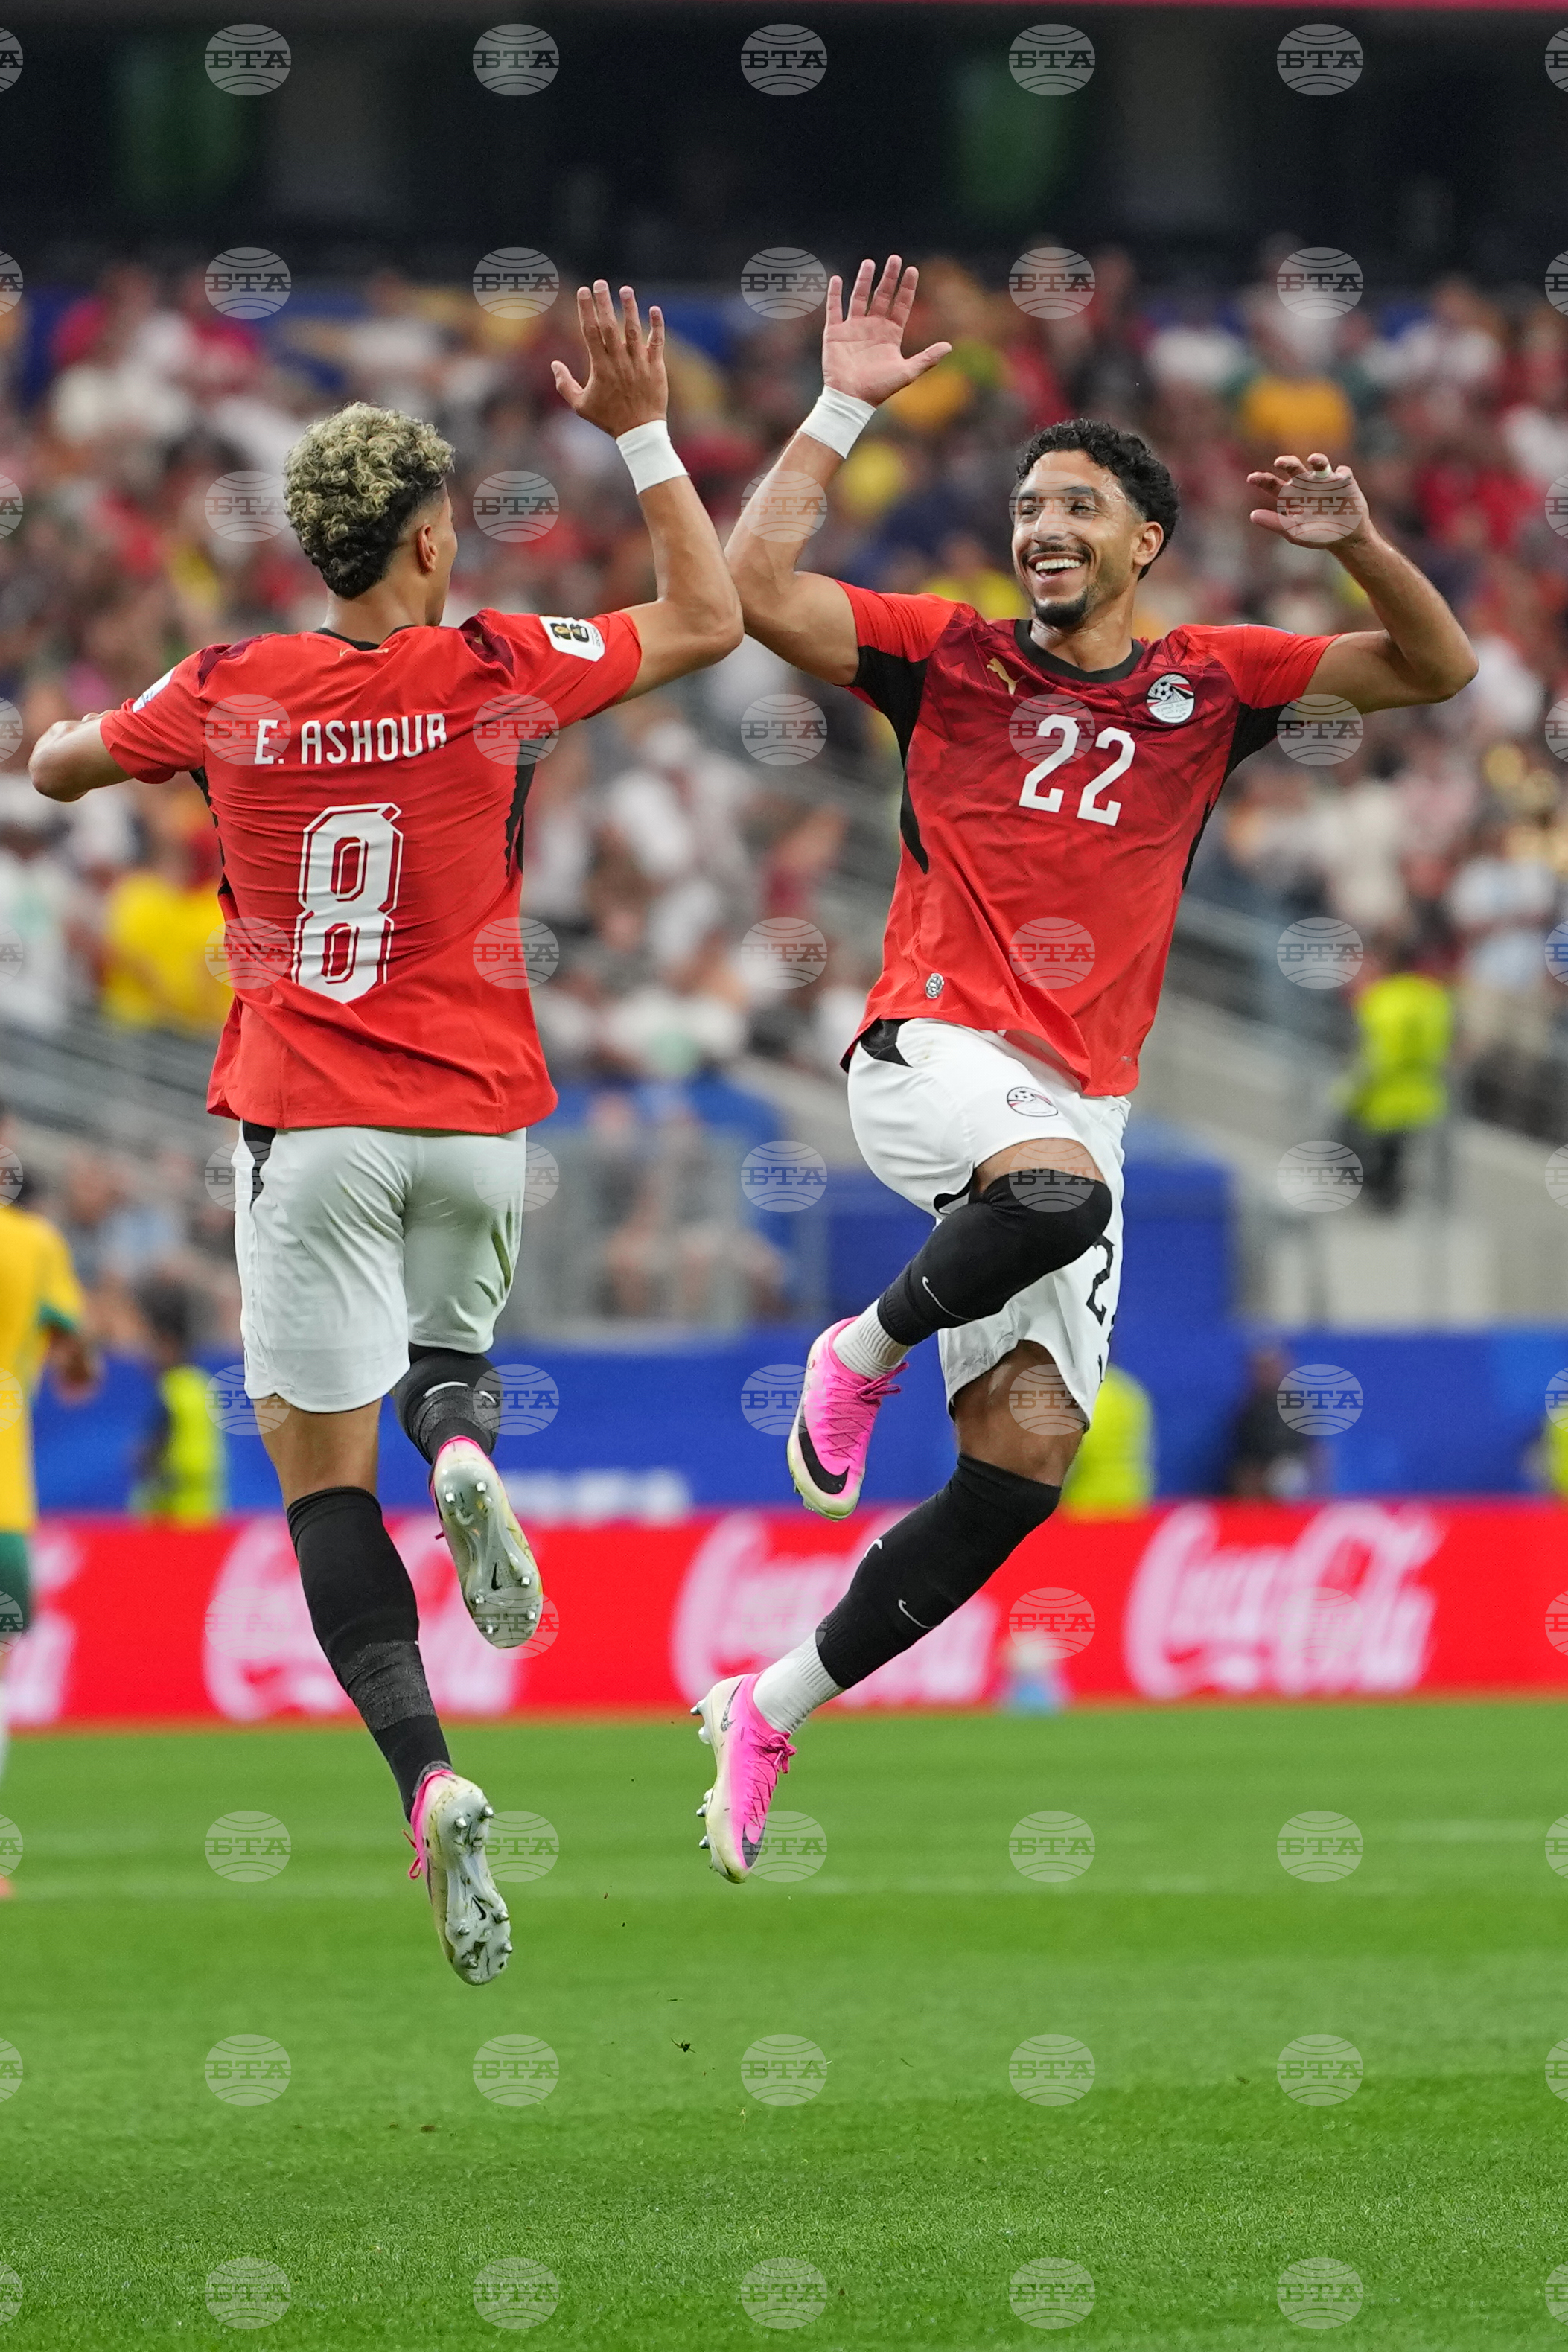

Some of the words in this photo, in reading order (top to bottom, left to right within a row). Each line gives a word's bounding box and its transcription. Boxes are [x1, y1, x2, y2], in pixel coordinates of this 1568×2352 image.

[254, 719, 284, 765] E.
[301, 713, 447, 764] ASHOUR
[1019, 713, 1136, 826] 22
[292, 802, 404, 1004] 8
